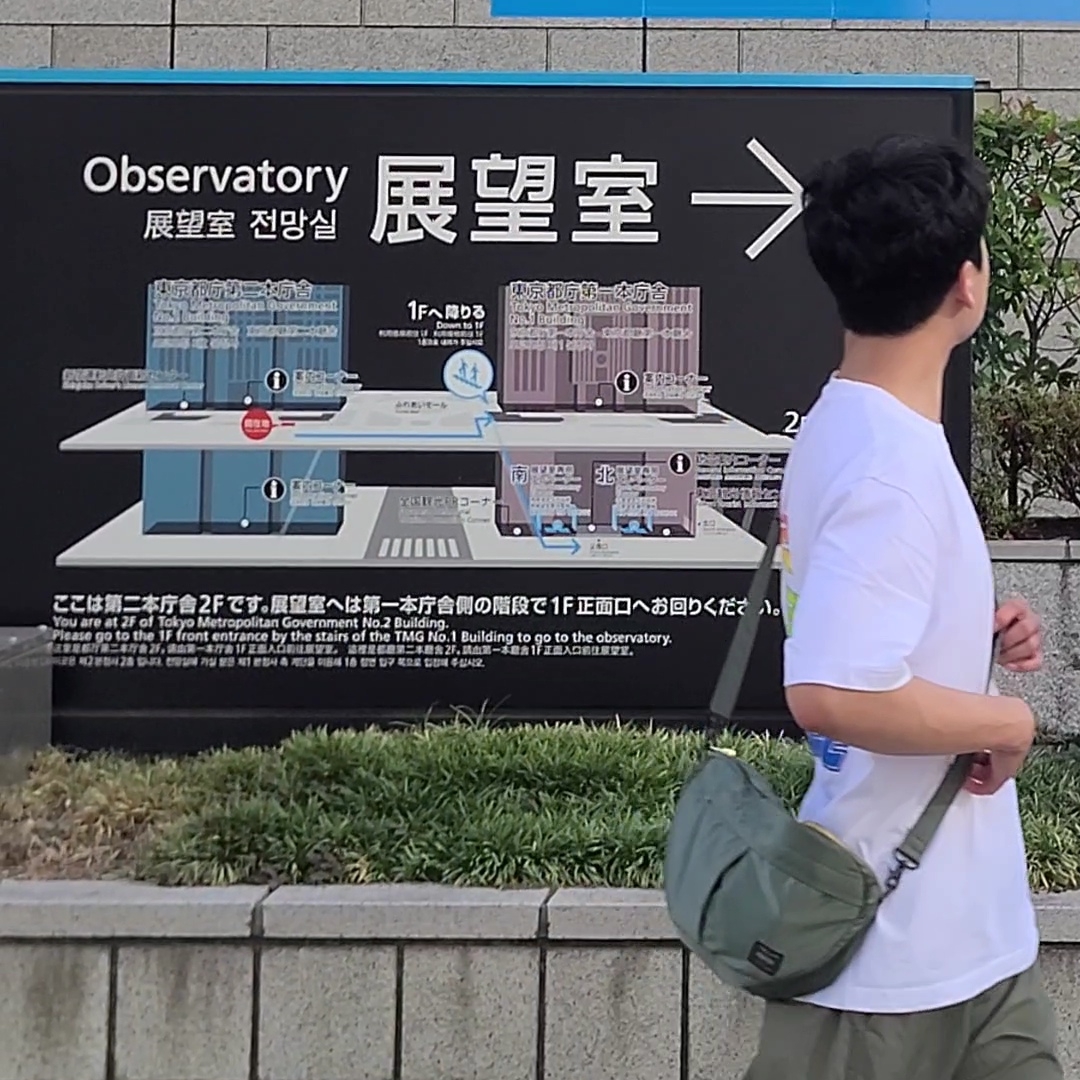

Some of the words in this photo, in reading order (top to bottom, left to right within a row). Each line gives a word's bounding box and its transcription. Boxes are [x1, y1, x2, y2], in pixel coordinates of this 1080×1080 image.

[83, 154, 349, 203] Observatory
[370, 153, 659, 244] 展望室
[143, 208, 236, 240] 展望室
[249, 207, 337, 240] 전망실
[511, 281, 669, 301] 東京都庁第一本庁舎
[407, 300, 486, 321] 1Fへ降りる
[511, 302, 544, 314] Tokyo
[546, 302, 620, 314] Metropolitan
[622, 302, 693, 313] Government
[53, 615, 77, 628] You
[81, 618, 101, 628] are
[105, 617, 117, 628] at
[122, 616, 136, 628] 2F
[140, 615, 153, 628] of
[158, 616, 194, 631] Tokyo
[198, 616, 278, 631] Metropolitan
[282, 617, 358, 629] Government
[363, 617, 391, 629] No.2
[395, 617, 449, 632] Building.
[53, 629, 92, 641] Please
[96, 632, 112, 644] go
[116, 630, 129, 641] to
[133, 629, 155, 641] the
[160, 629, 172, 641] 1F
[176, 629, 208, 641] front
[212, 630, 268, 642] entrance
[272, 629, 287, 645] by
[291, 630, 313, 642] the
[316, 630, 349, 642] stairs
[352, 630, 366, 642] of
[370, 630, 390, 642] the
[394, 631, 424, 642] TMG
[428, 630, 457, 642] No.1
[461, 630, 513, 645] Building
[517, 631, 531, 642] to
[535, 633, 552, 645] go
[555, 632, 569, 642] to
[572, 631, 593, 643] the
[596, 631, 673, 645] observatory.
